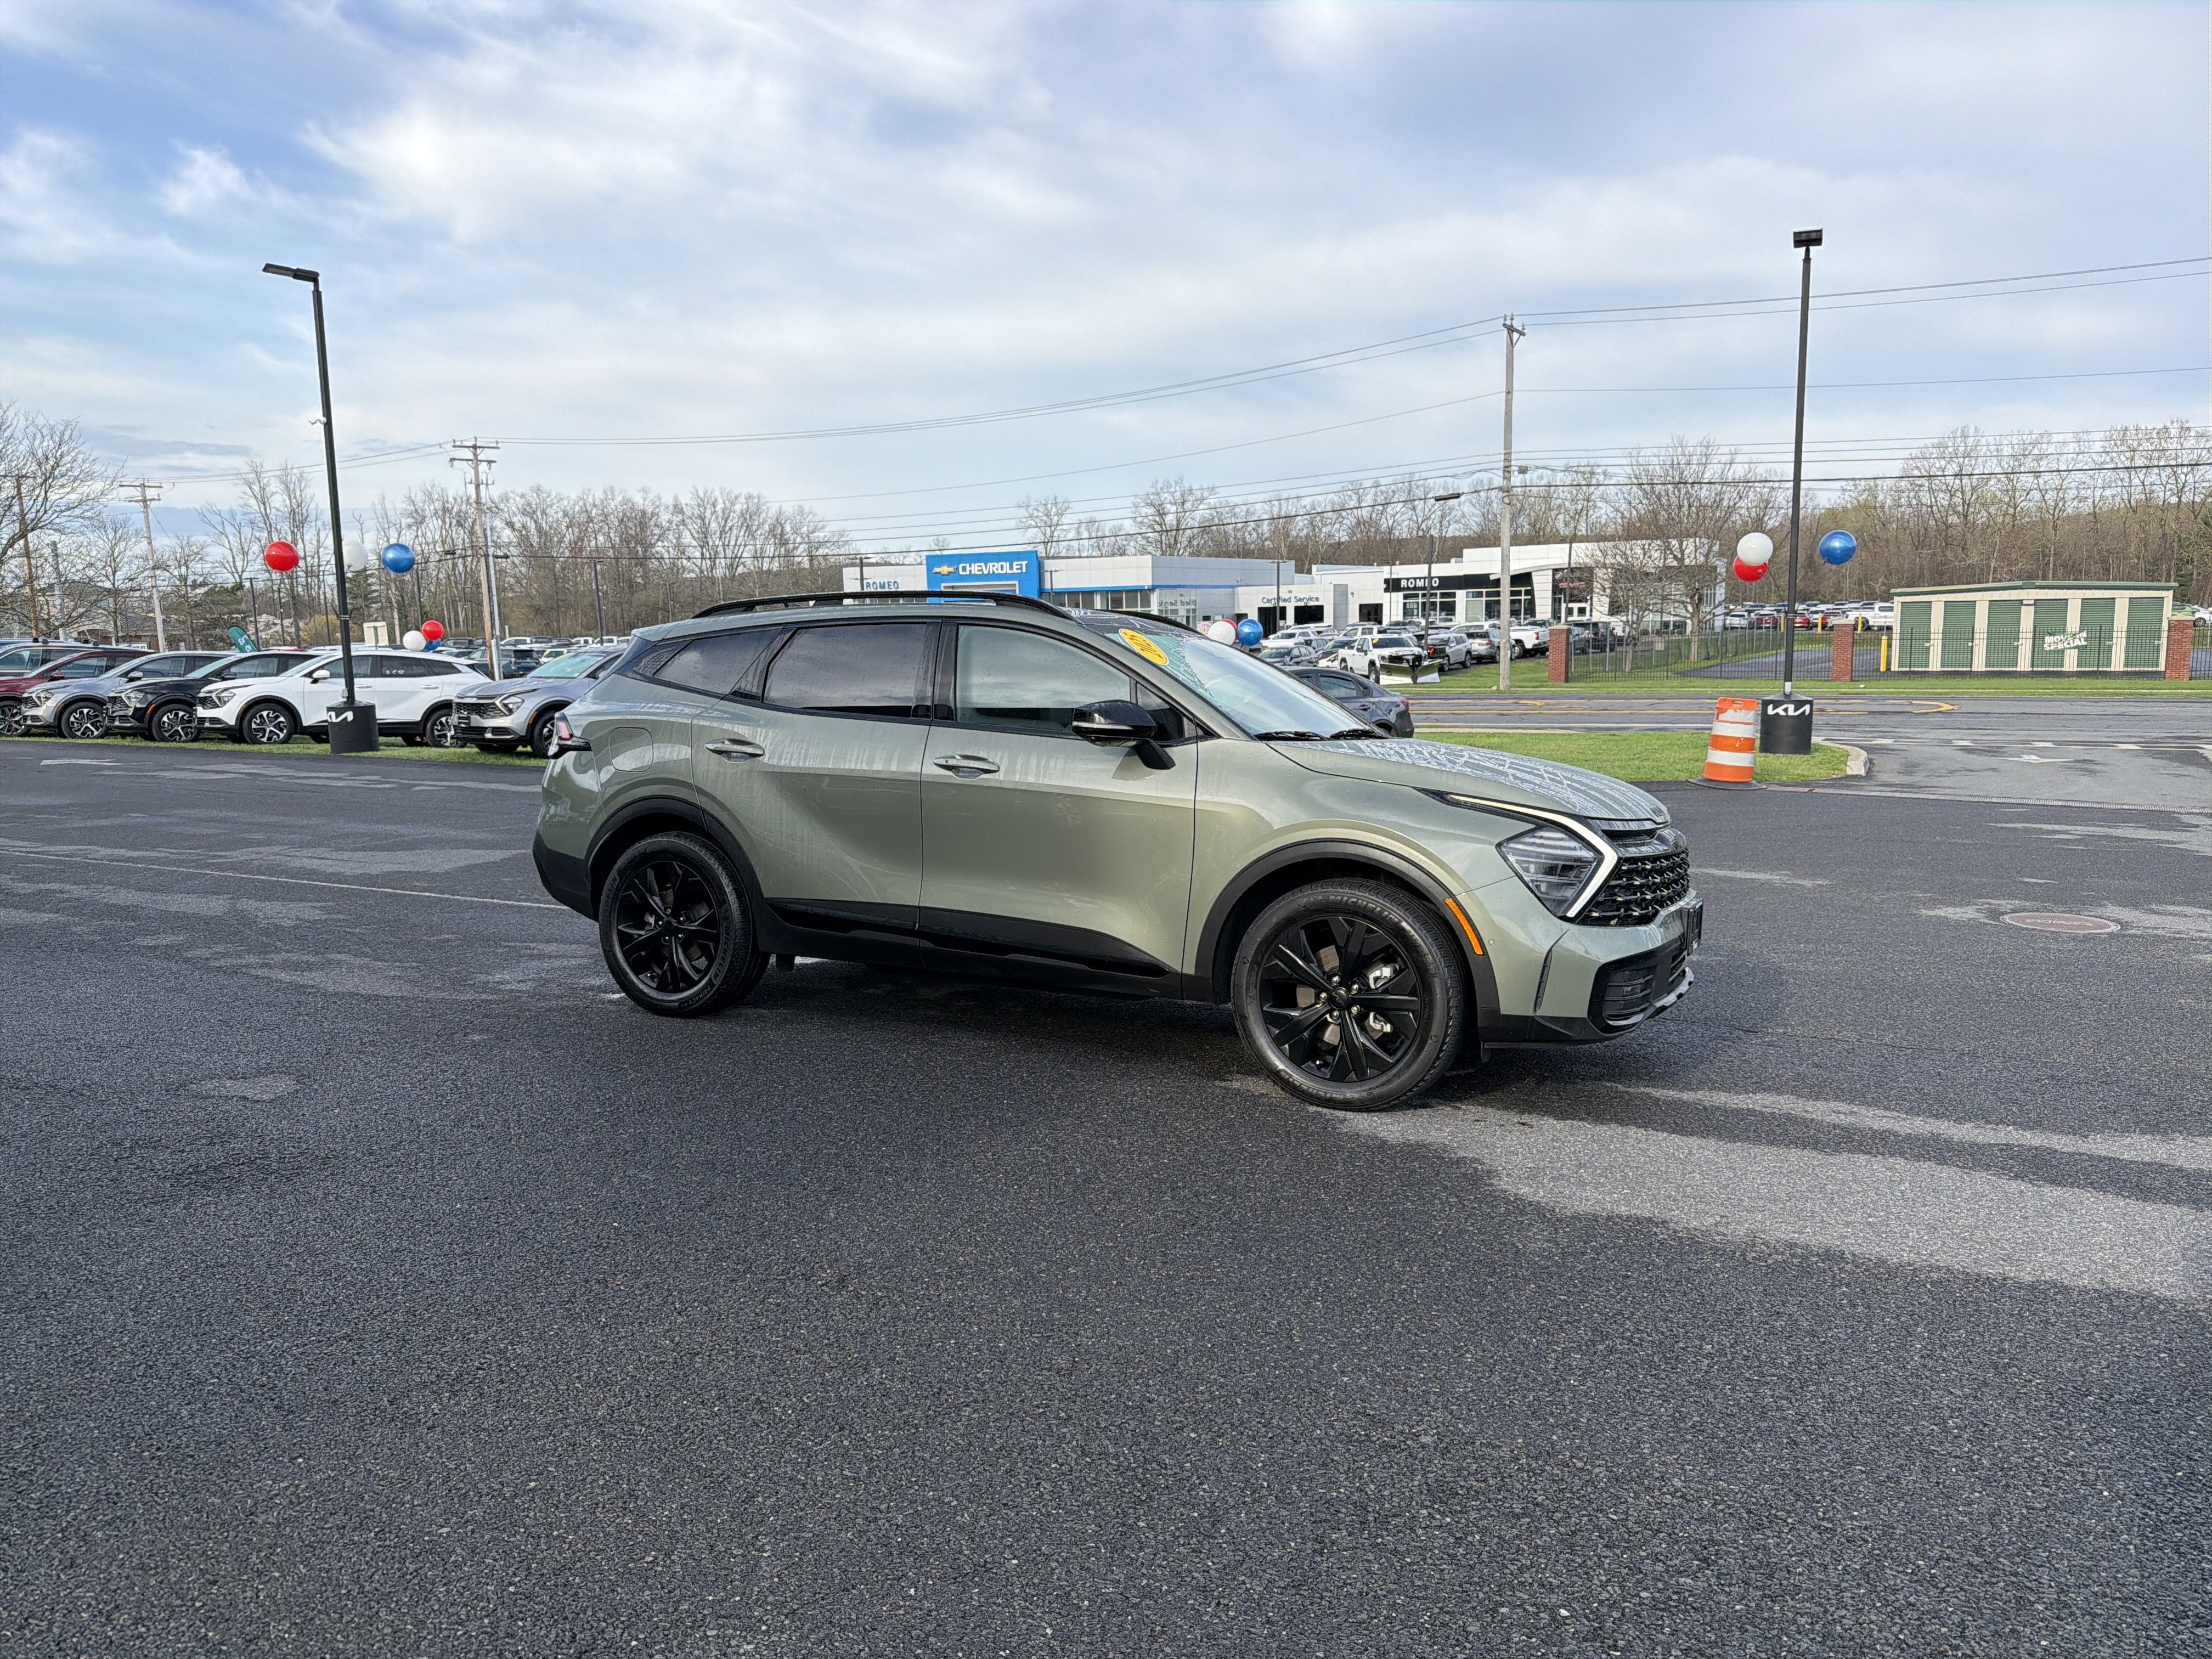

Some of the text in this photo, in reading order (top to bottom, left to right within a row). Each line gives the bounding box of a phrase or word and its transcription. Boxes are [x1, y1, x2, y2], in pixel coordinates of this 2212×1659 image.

[958, 561, 1028, 575] CHEVROLET
[866, 580, 900, 590] ROMEO
[2045, 629, 2087, 644] MOVE-IN
[2043, 637, 2087, 651] SPECIAL
[1767, 703, 1810, 716] KIA
[713, 925, 730, 981] MICHELIN
[689, 985, 712, 1005] PRIMACY
